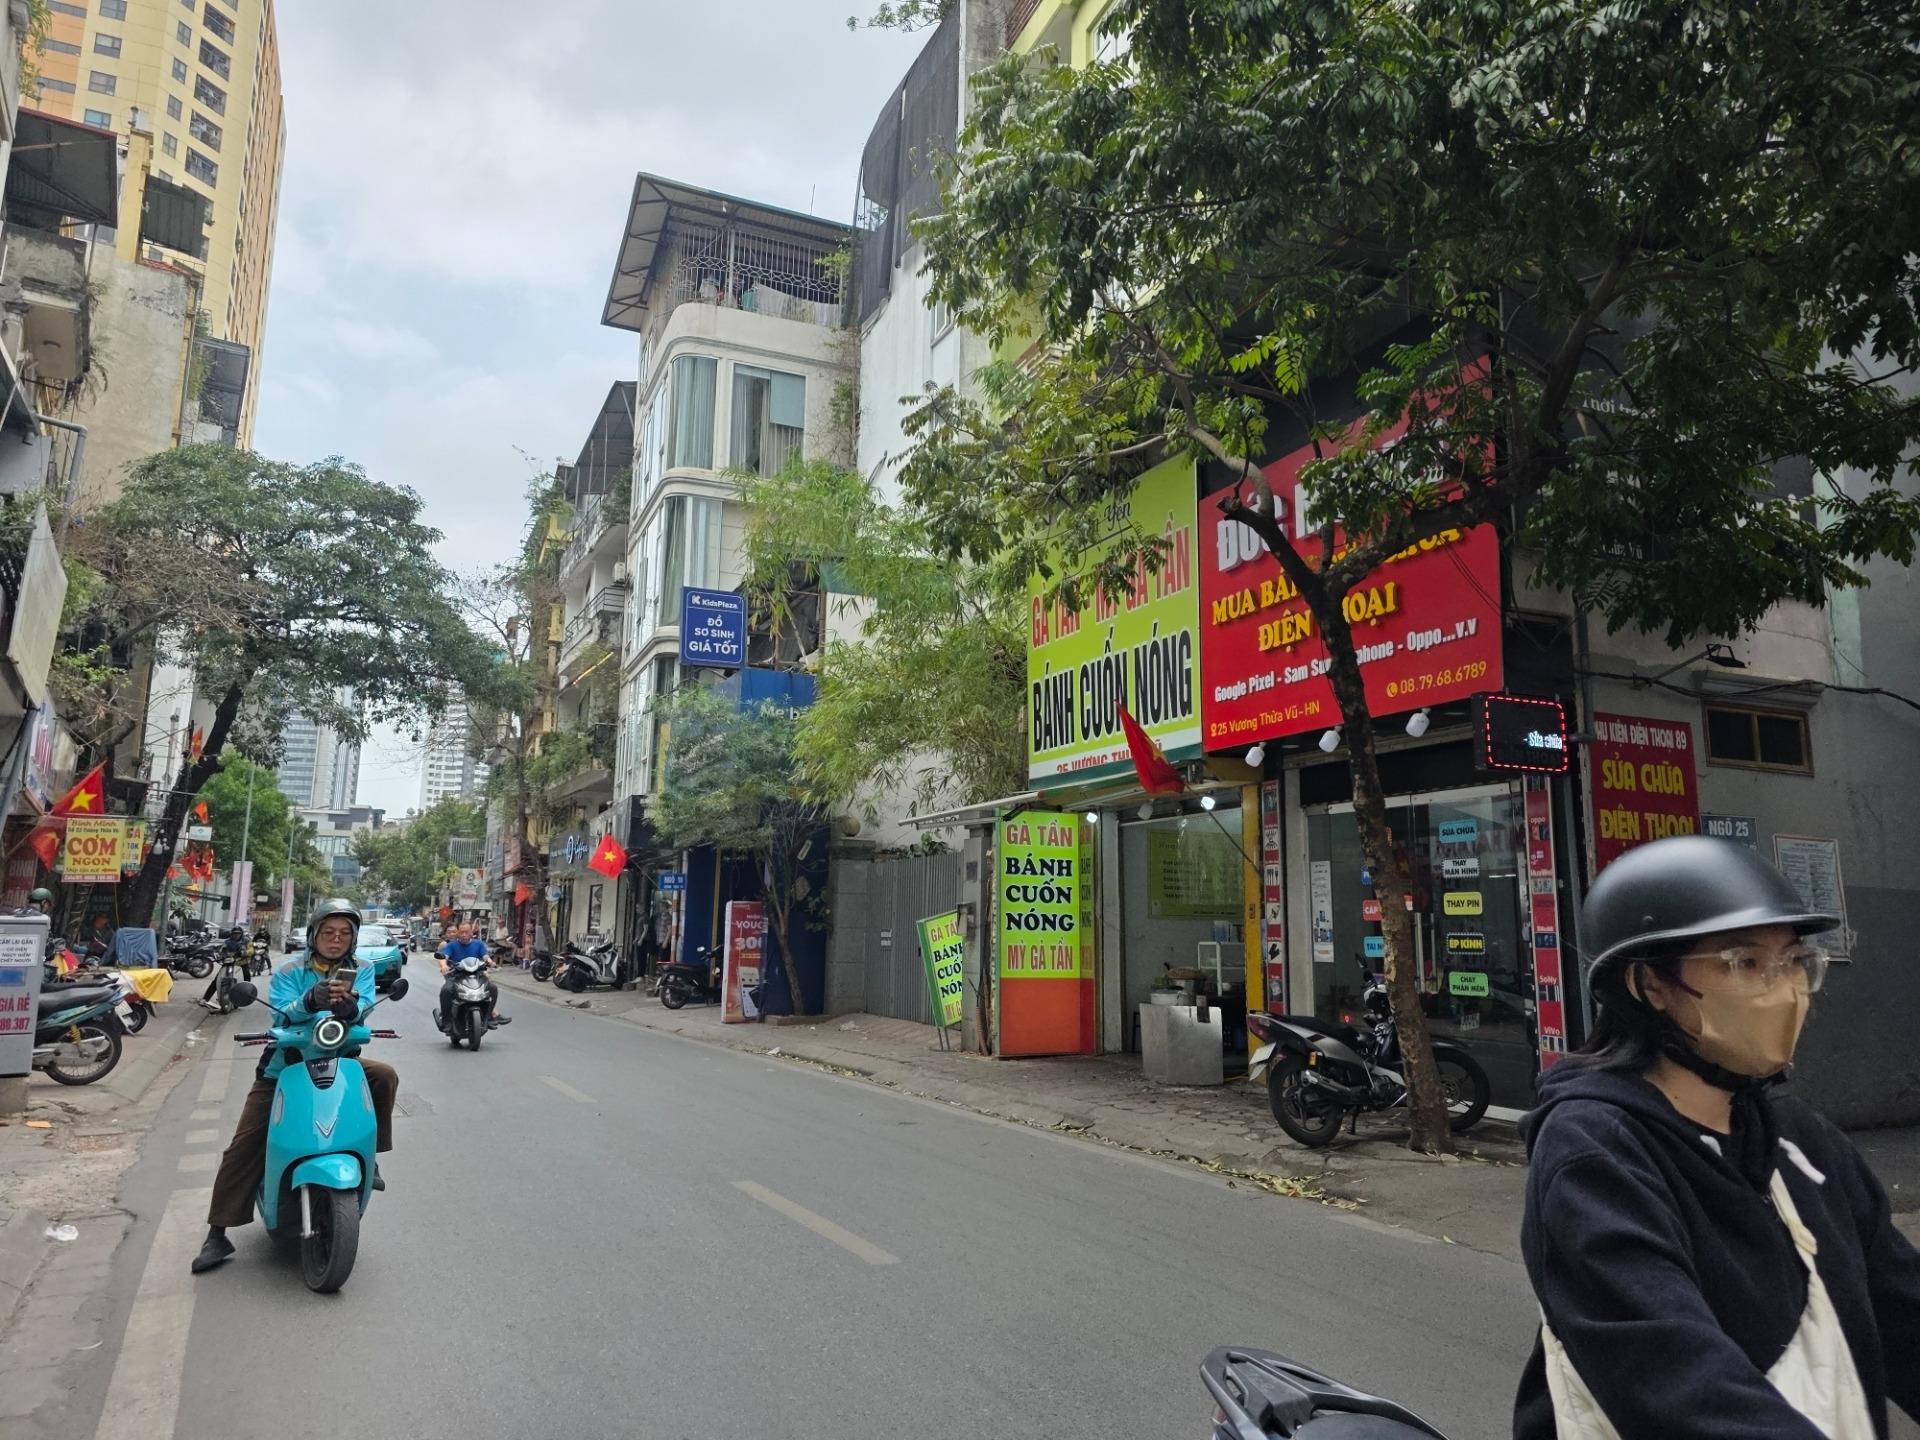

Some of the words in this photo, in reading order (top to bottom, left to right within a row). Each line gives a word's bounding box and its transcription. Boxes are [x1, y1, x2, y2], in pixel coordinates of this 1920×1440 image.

[702, 599, 739, 609] KidsPlaza
[1213, 588, 1256, 625] MUA
[694, 627, 709, 636] SƠ
[710, 629, 735, 639] SINH
[707, 614, 723, 627] ĐỒ
[1259, 609, 1312, 653] ĐIỆN
[689, 639, 712, 653] GIÁ
[713, 640, 739, 655] TỐT
[1033, 662, 1075, 752] BÁNH
[1080, 626, 1129, 741] CUỐN
[1134, 622, 1193, 726] NÓNG
[1215, 681, 1247, 702] Google
[1250, 671, 1275, 692] Pixel
[1285, 665, 1308, 684] Sam
[1400, 661, 1488, 694] 08.79.68.6789
[1217, 723, 1228, 736] 25
[1229, 718, 1258, 731] Vương
[1260, 709, 1283, 725] Thừa
[1609, 718, 1629, 748] KIỆN
[1629, 722, 1649, 750] ĐIỆN
[1675, 730, 1687, 749] 89
[1602, 752, 1636, 791] SỬA
[1641, 761, 1685, 796] CHỮA
[1006, 820, 1031, 845] GÀ
[1037, 819, 1073, 847] TẦN
[1600, 803, 1641, 846] ĐIỆN
[1708, 817, 1733, 837] NGÕ
[1735, 821, 1749, 837] 25
[67, 833, 118, 856] CƠM
[72, 857, 111, 865] NGON
[1005, 853, 1073, 876] BÁNH
[1005, 878, 1073, 904] CUỐN
[1005, 908, 1075, 931] NÓNG
[1031, 940, 1046, 970] GÀ
[1050, 937, 1073, 970] TẦN
[937, 957, 963, 979] CUỐ
